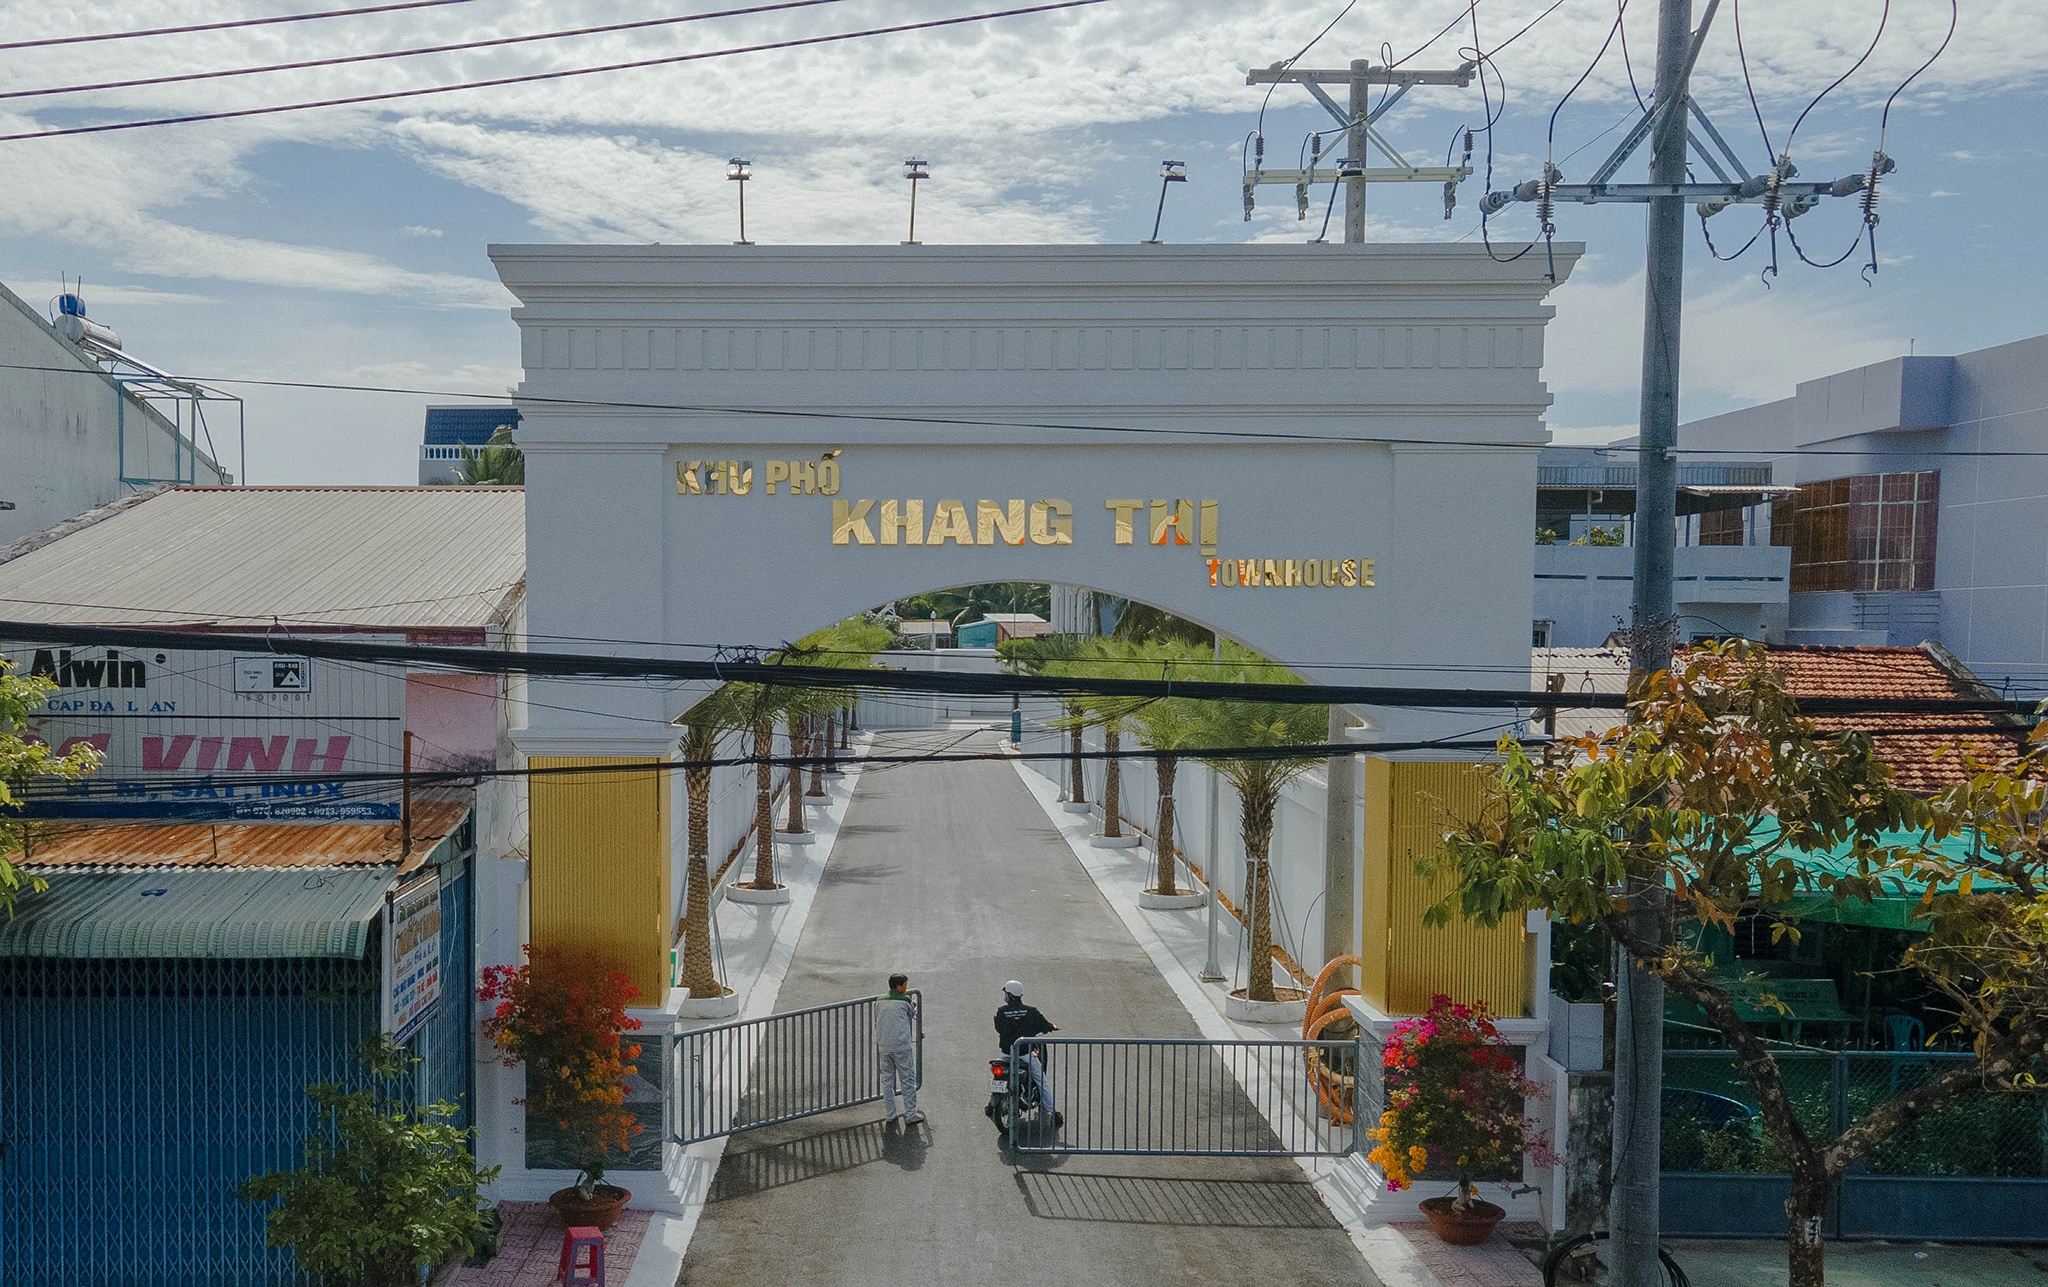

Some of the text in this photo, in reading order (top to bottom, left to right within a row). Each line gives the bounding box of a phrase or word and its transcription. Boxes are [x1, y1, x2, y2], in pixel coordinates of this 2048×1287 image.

[676, 449, 842, 496] KHU PHỐ
[832, 499, 1218, 556] KHANG THỊ
[1206, 557, 1376, 588] TOWNHOUSE
[142, 734, 351, 773] VINH
[261, 781, 346, 799] INOX
